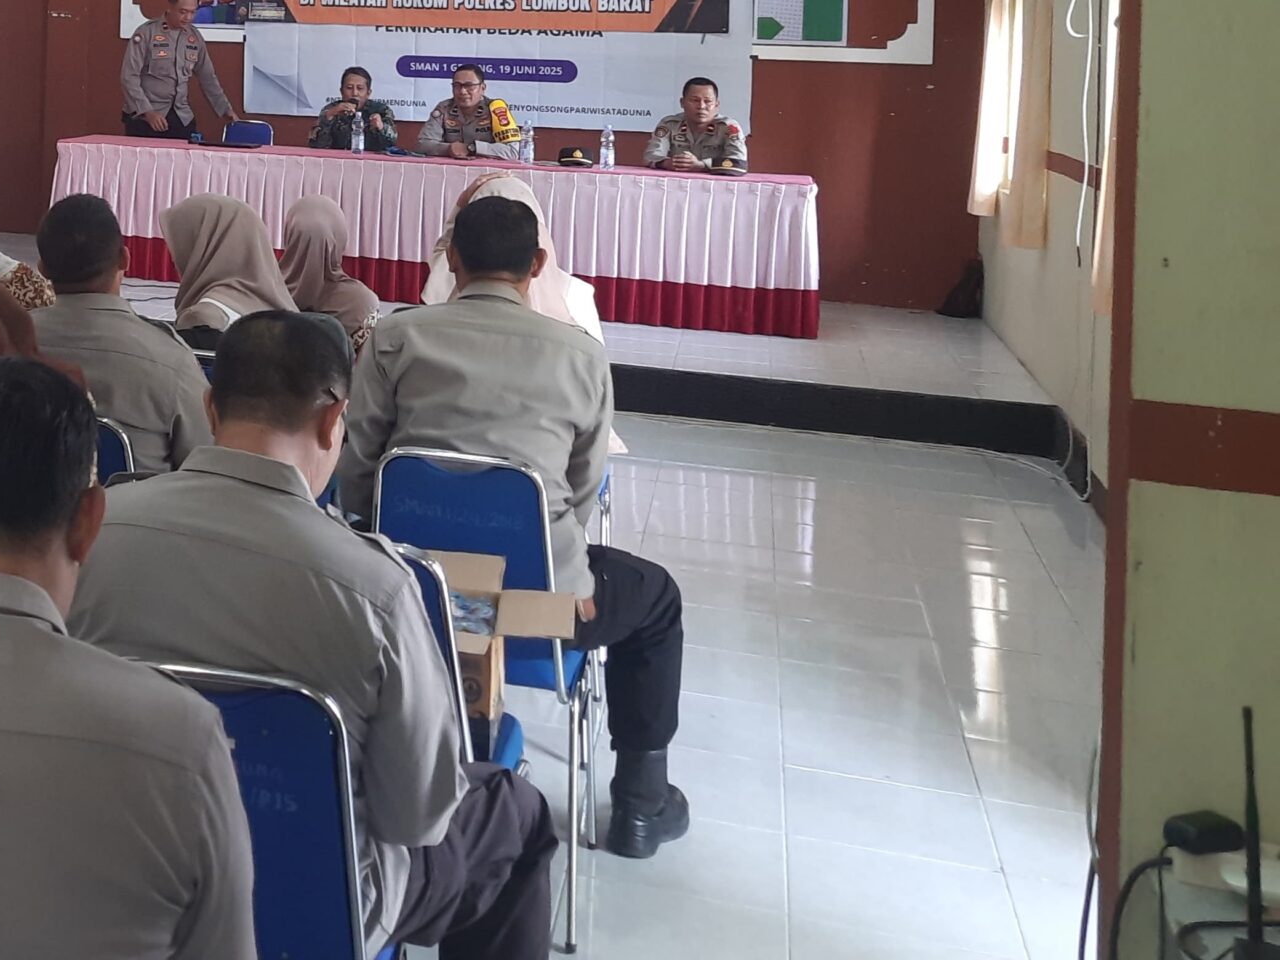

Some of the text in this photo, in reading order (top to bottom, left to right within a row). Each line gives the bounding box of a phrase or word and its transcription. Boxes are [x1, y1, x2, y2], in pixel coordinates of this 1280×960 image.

[410, 62, 440, 71] SMAN
[443, 63, 447, 71] 1
[499, 65, 511, 74] 19
[512, 65, 536, 75] JUNI
[538, 66, 563, 75] 2025
